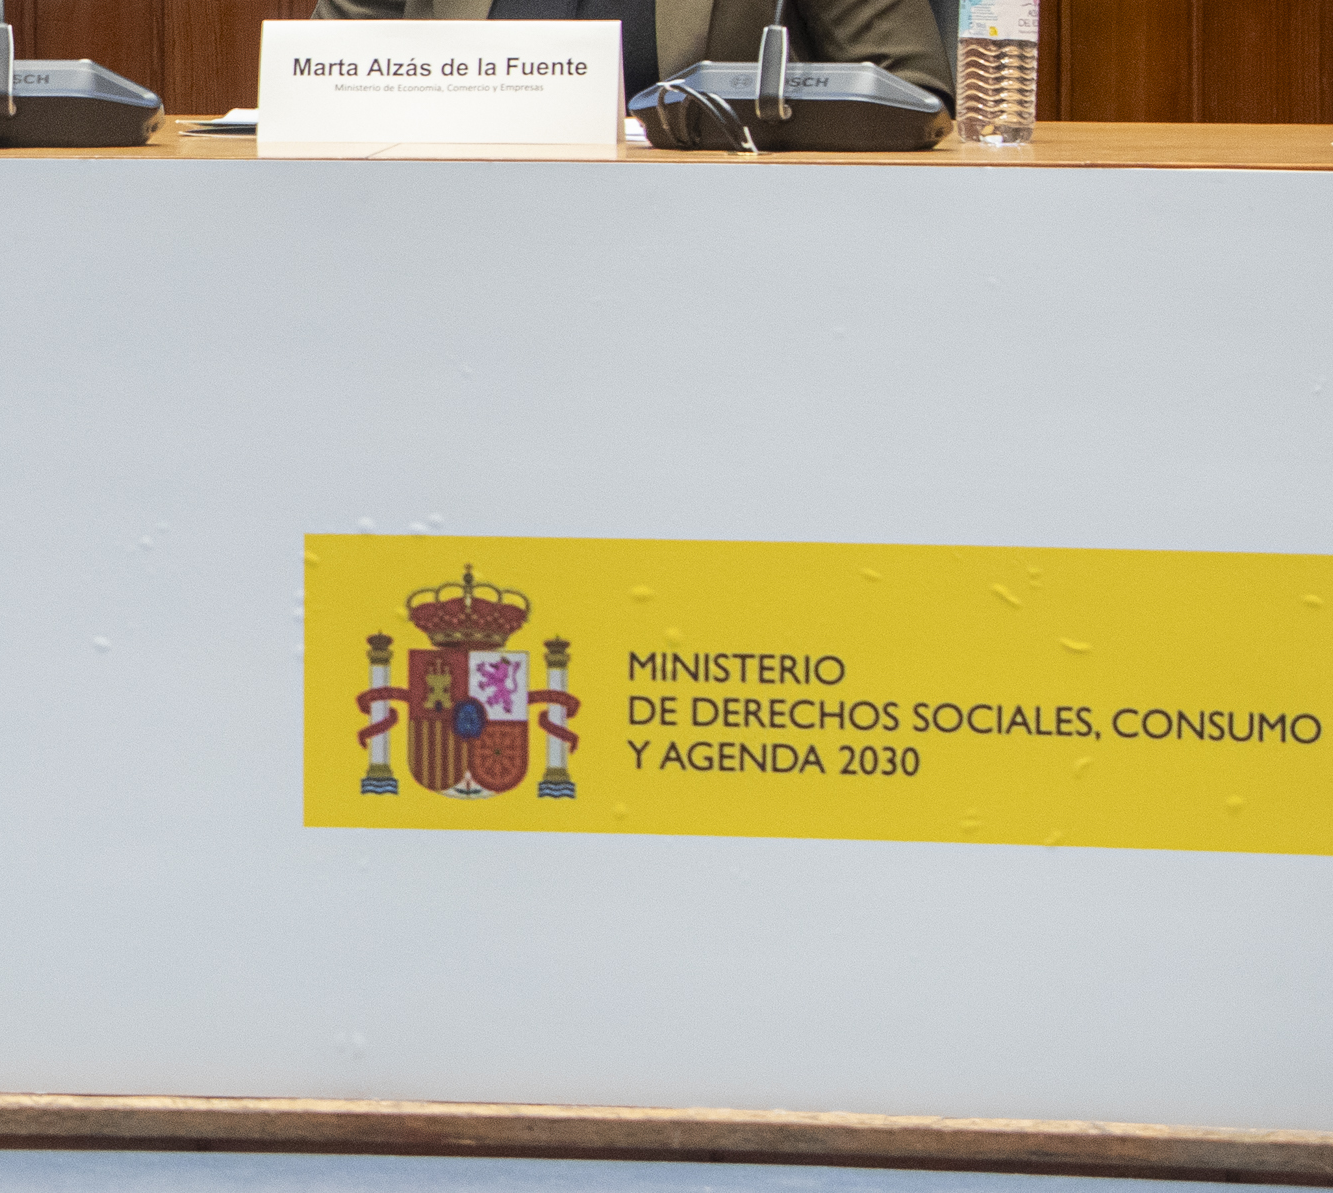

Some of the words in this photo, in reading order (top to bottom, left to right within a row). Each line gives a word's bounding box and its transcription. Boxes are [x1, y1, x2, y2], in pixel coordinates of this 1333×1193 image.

[292, 57, 359, 77] Marta
[366, 57, 432, 77] Alzás
[440, 57, 469, 77] de
[477, 57, 497, 77] la
[505, 57, 588, 77] Fuente
[334, 83, 381, 93] Ministerio
[383, 83, 395, 93] de
[447, 83, 491, 93] Comercio
[492, 84, 499, 94] y
[500, 83, 545, 94] Empresas
[628, 652, 846, 687] MINISTERIO
[628, 695, 678, 727] DE
[691, 696, 900, 732] DERECHOS
[912, 702, 1102, 740] SOCIALES,
[1111, 707, 1323, 745] CONSUMO
[627, 740, 652, 770] Y
[659, 740, 826, 774] AGENDA
[838, 745, 921, 778] 2030
